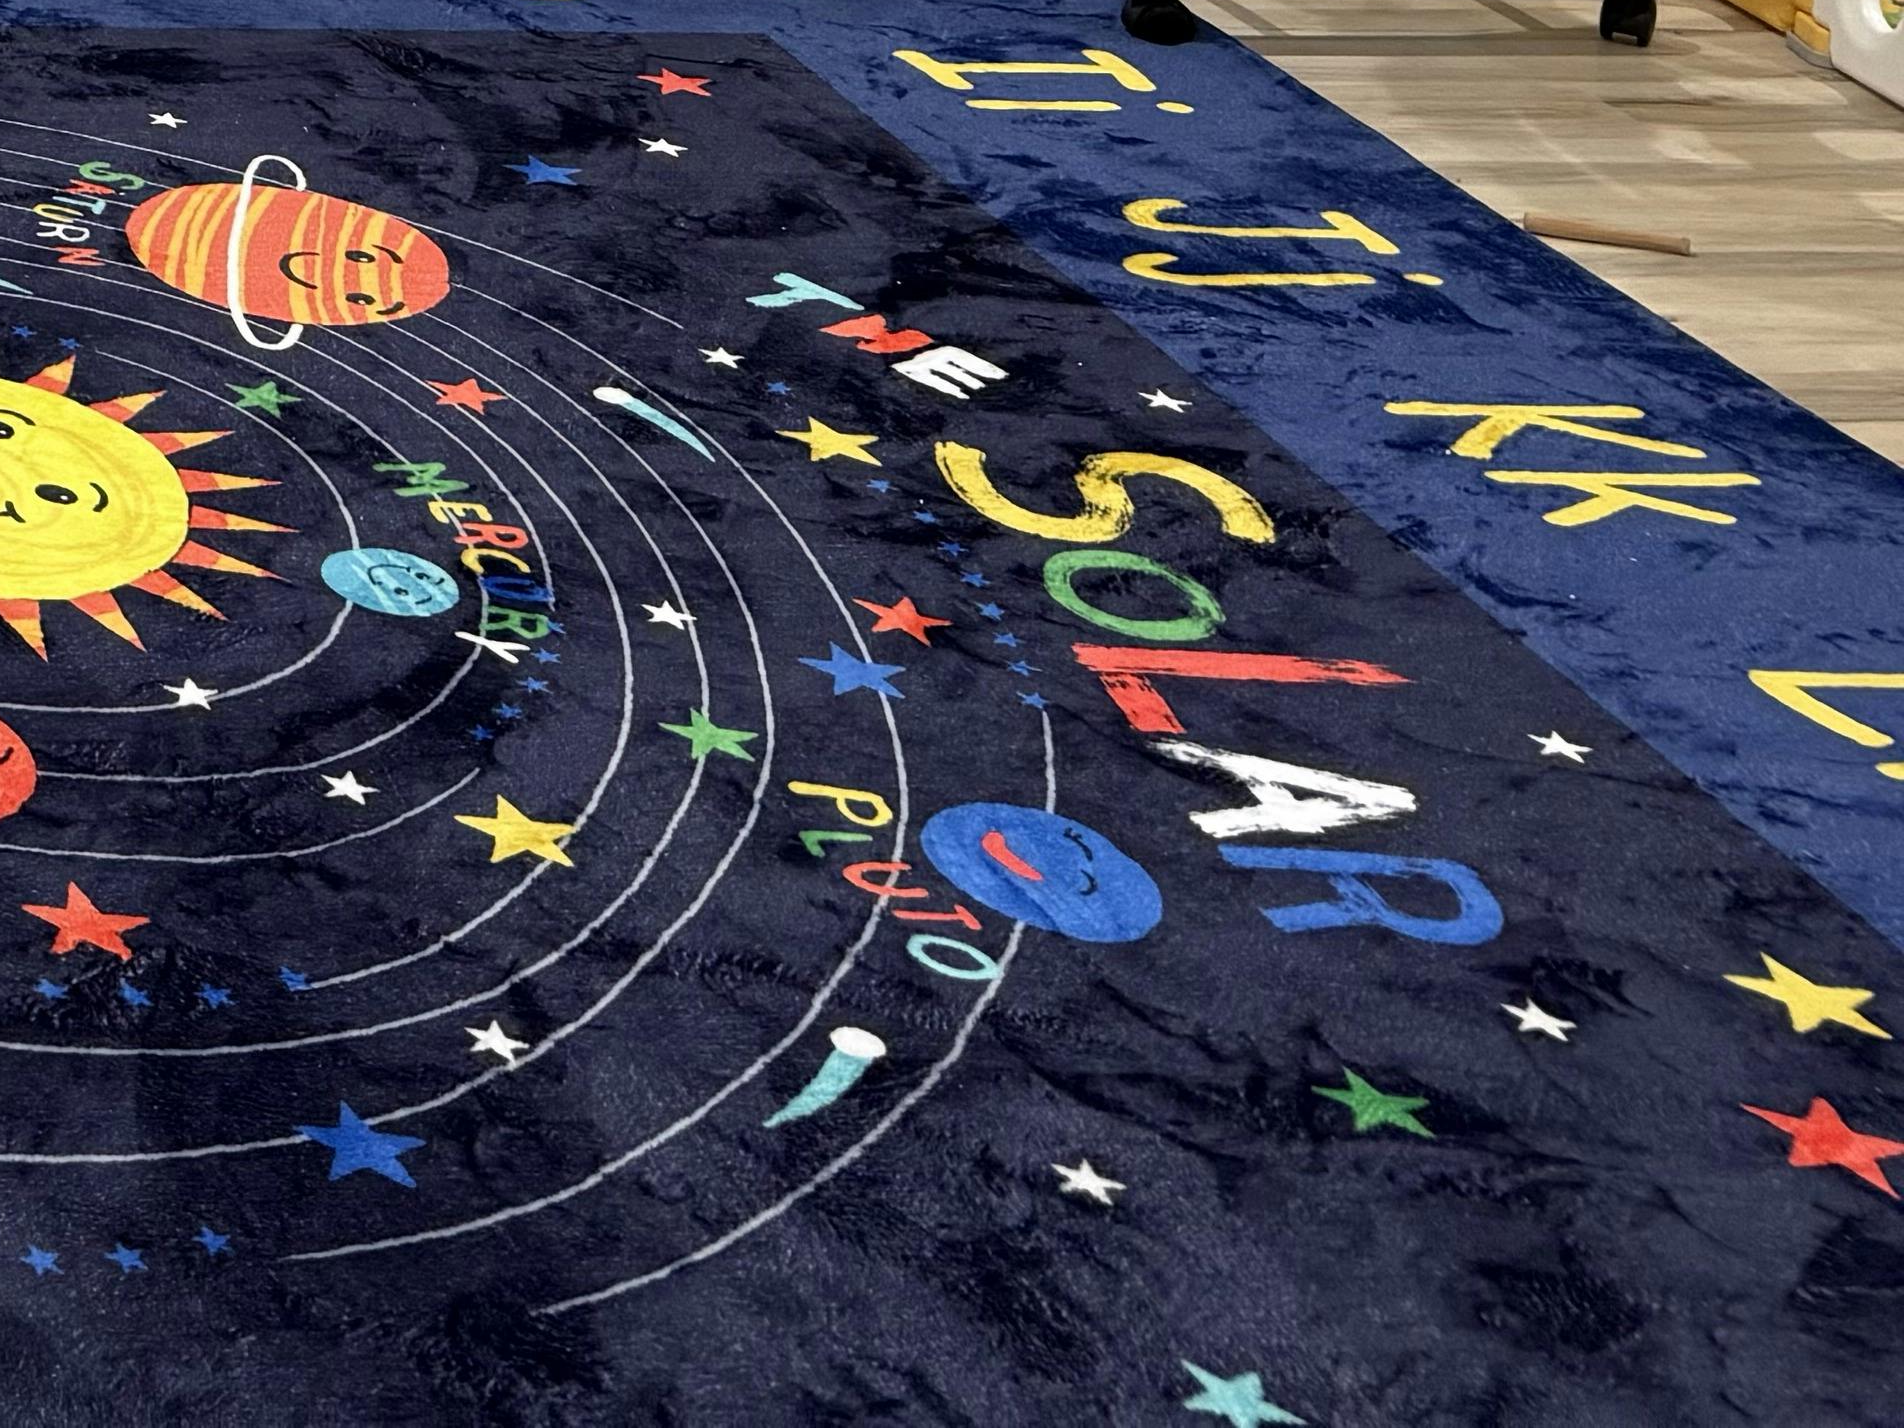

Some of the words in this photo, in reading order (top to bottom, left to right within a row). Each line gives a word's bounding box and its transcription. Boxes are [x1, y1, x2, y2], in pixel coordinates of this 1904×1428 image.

[31, 160, 146, 267] SATURN
[372, 460, 556, 665] MERCURY
[934, 440, 1506, 946] SOLAR
[787, 779, 1000, 981] PLUTO
